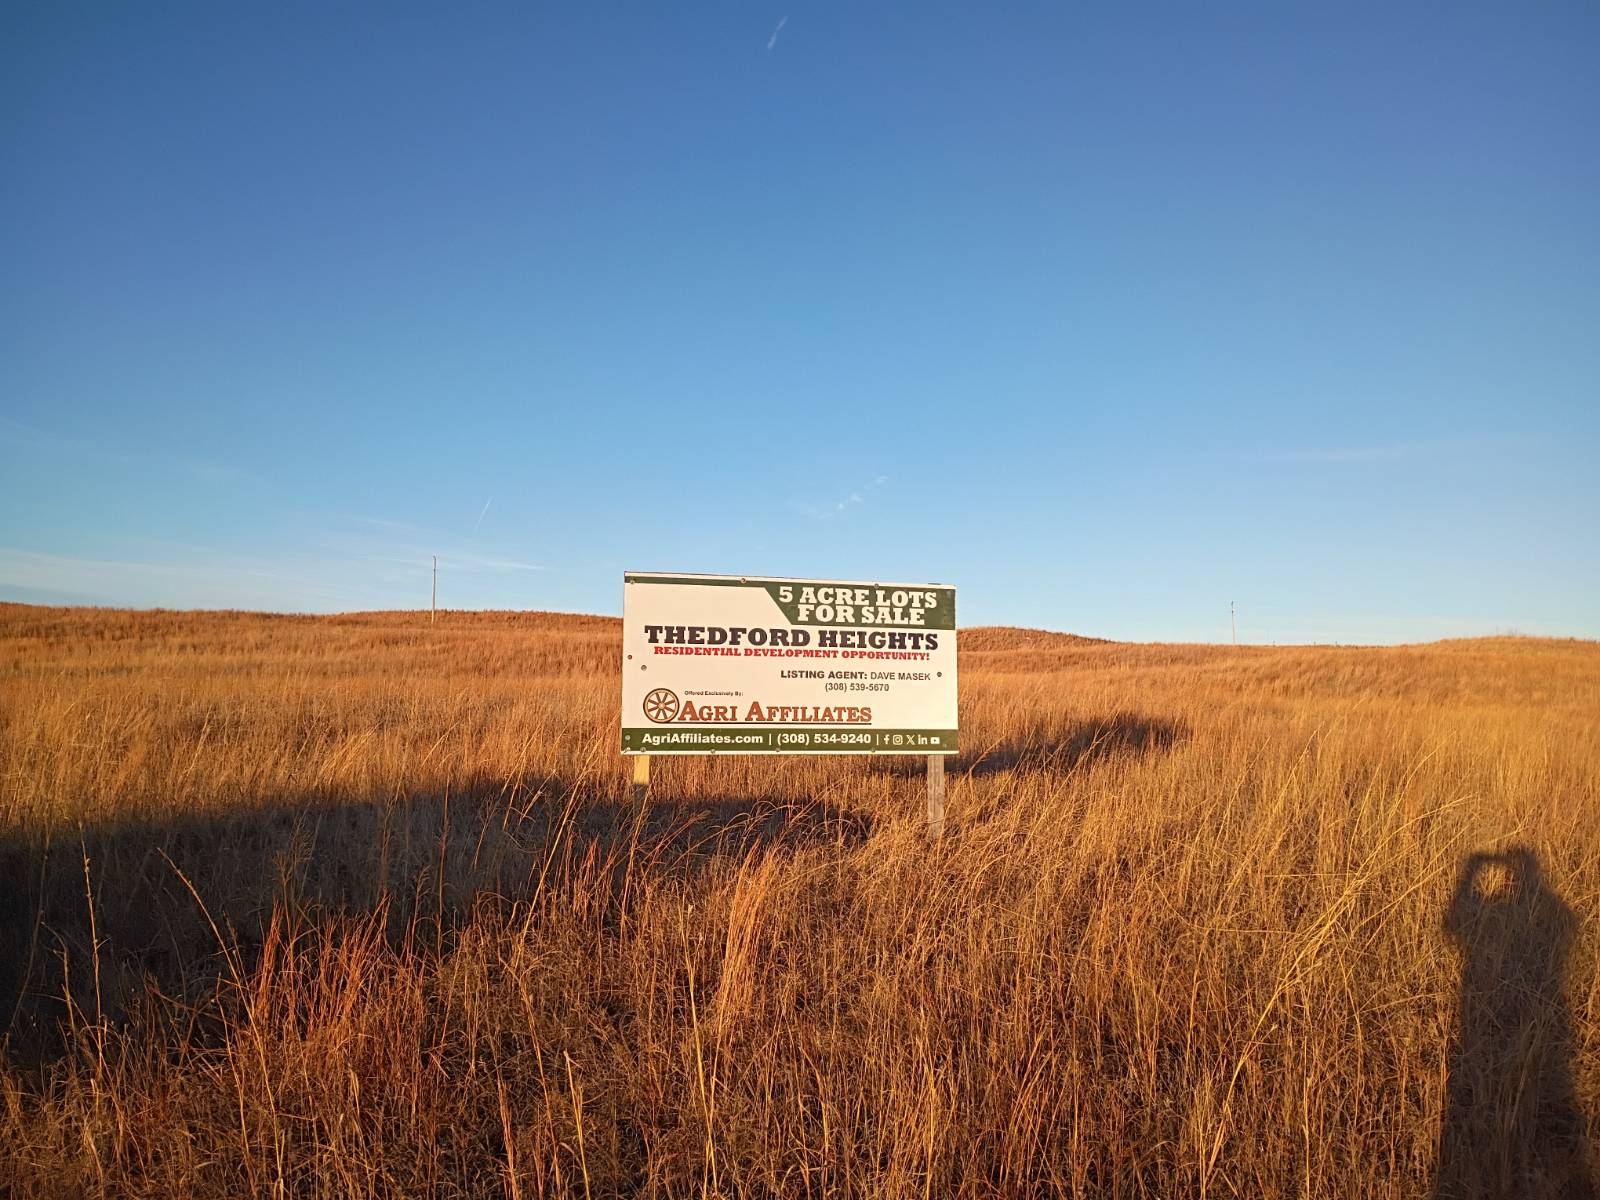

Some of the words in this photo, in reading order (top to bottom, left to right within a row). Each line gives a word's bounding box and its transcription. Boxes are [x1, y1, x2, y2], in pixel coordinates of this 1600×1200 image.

[779, 587, 792, 602] 5
[800, 587, 869, 606] ACRE
[876, 590, 937, 608] LOTS
[798, 605, 855, 623] FOR
[861, 607, 924, 625] SALE
[644, 625, 810, 647] THEDFORD
[818, 630, 938, 650] HEIGHTS
[654, 646, 742, 656] RESIDENTIAL
[744, 648, 838, 658] DEVELOPMENT
[841, 651, 930, 660] OPPORTUNITY!
[781, 670, 825, 679] LISTING
[828, 671, 867, 680] AGENT:
[870, 672, 896, 680] DAVE
[898, 672, 931, 681] MASEK
[825, 682, 847, 692] (308)
[678, 700, 737, 721] AGRI
[745, 702, 872, 722] AFFILIATES
[642, 733, 763, 744] AgriAffiliates.com
[777, 734, 810, 744] (308)
[814, 734, 871, 744] 534-9240
